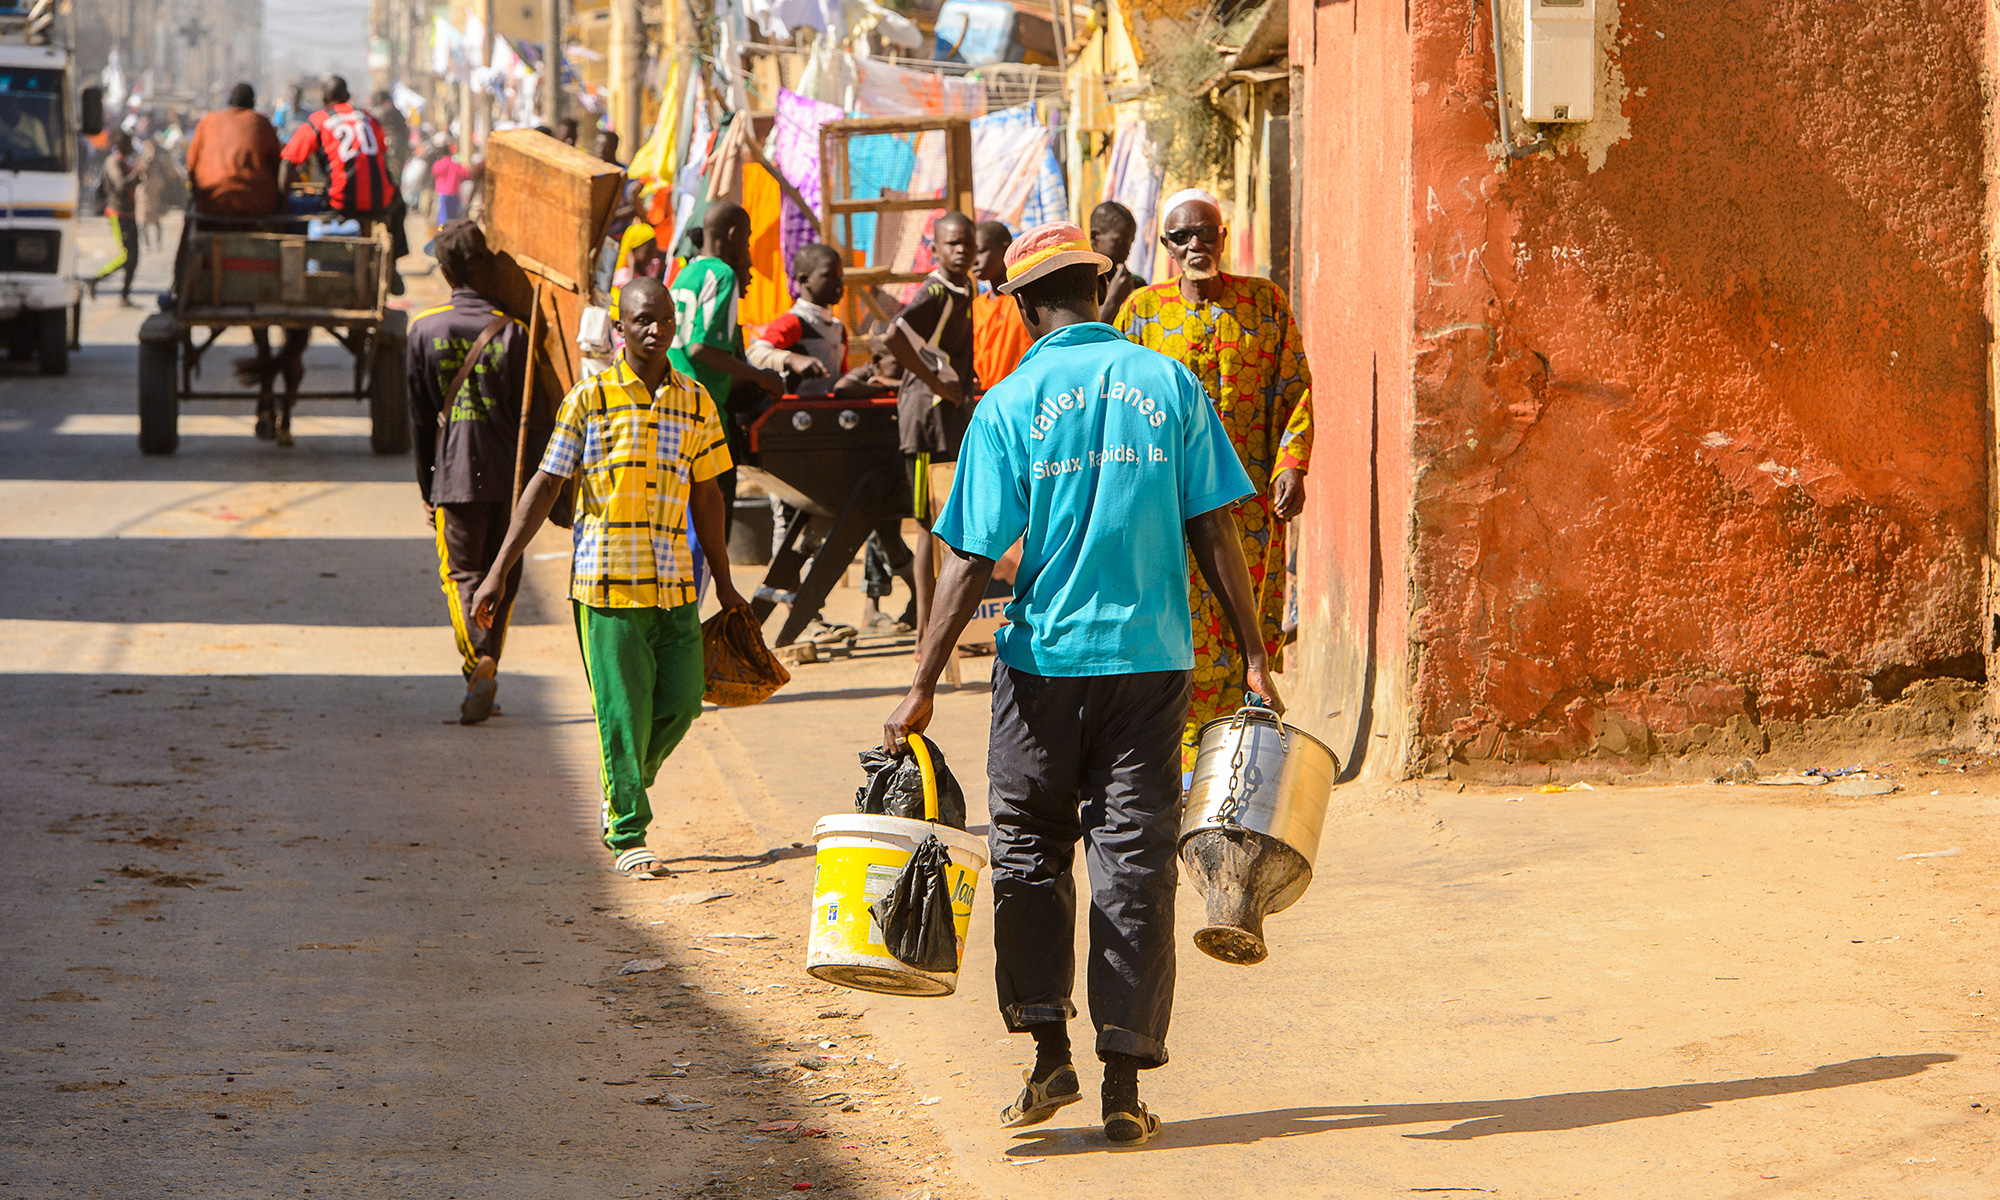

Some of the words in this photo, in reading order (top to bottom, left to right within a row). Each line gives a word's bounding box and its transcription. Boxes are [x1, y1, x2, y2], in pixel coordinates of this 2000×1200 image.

[333, 122, 378, 162] 20
[1100, 375, 1167, 427] Lanes
[1032, 457, 1082, 480] Sioux
